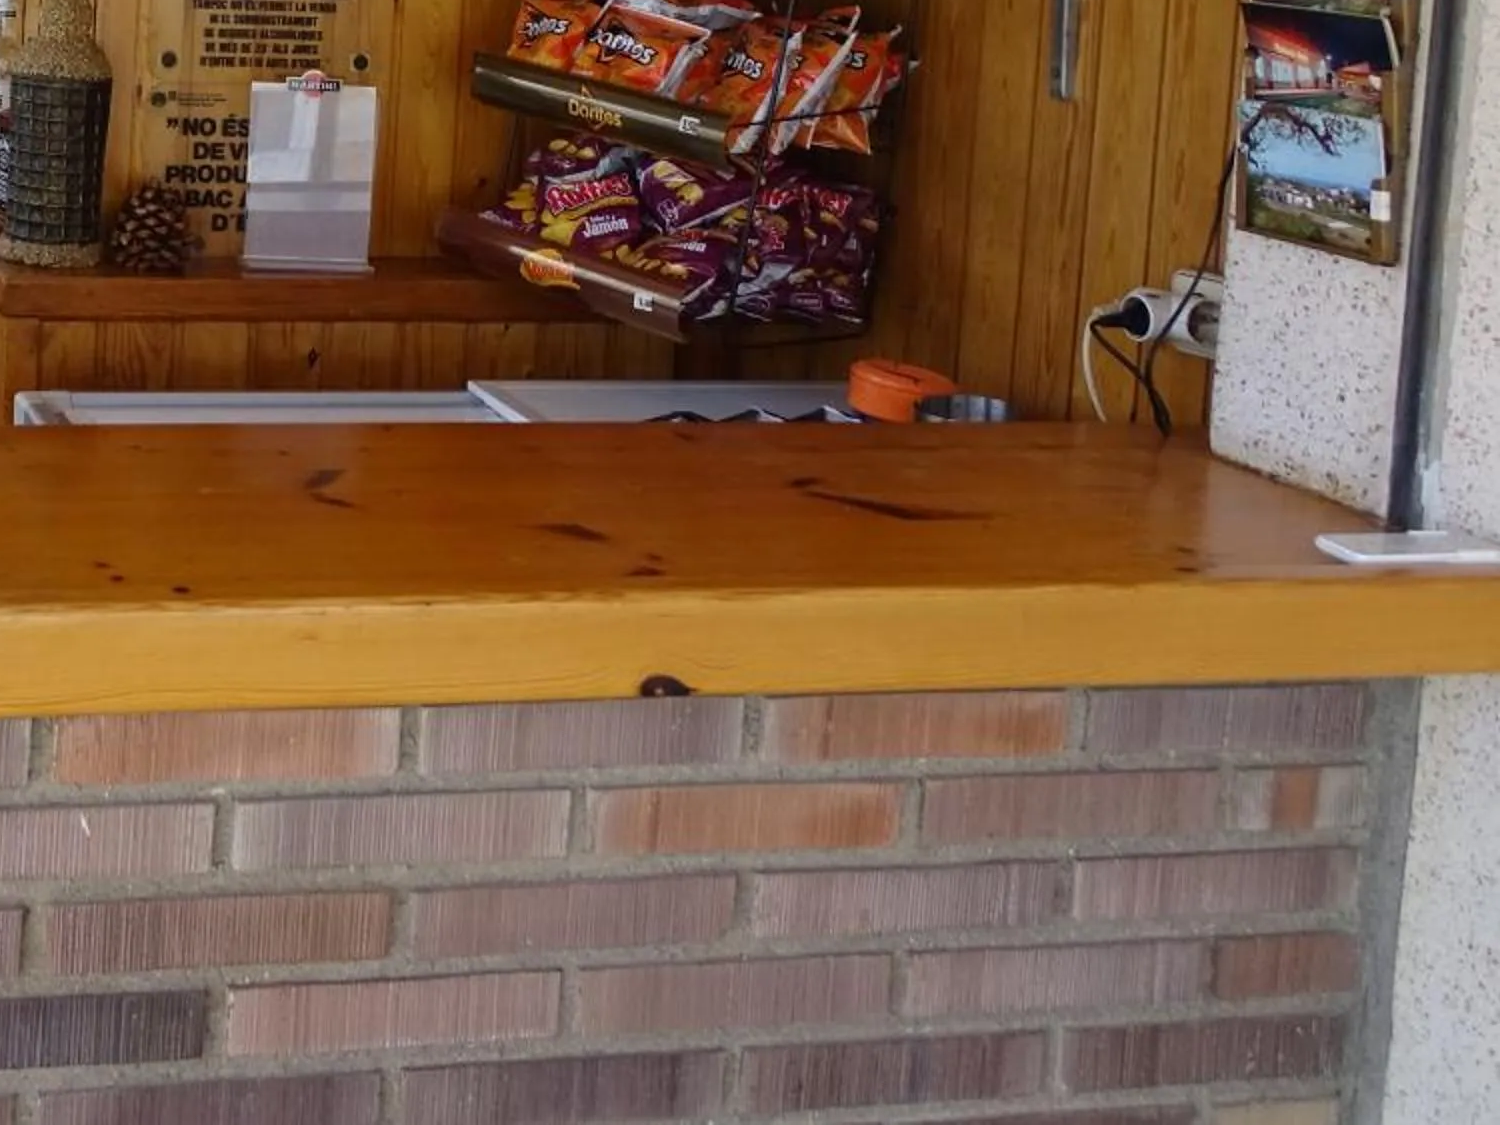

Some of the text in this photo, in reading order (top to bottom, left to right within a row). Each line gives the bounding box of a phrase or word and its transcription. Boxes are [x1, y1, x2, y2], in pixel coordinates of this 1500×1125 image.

[567, 98, 623, 129] Doritos
[193, 142, 224, 160] DE
[582, 215, 629, 239] Jamón
